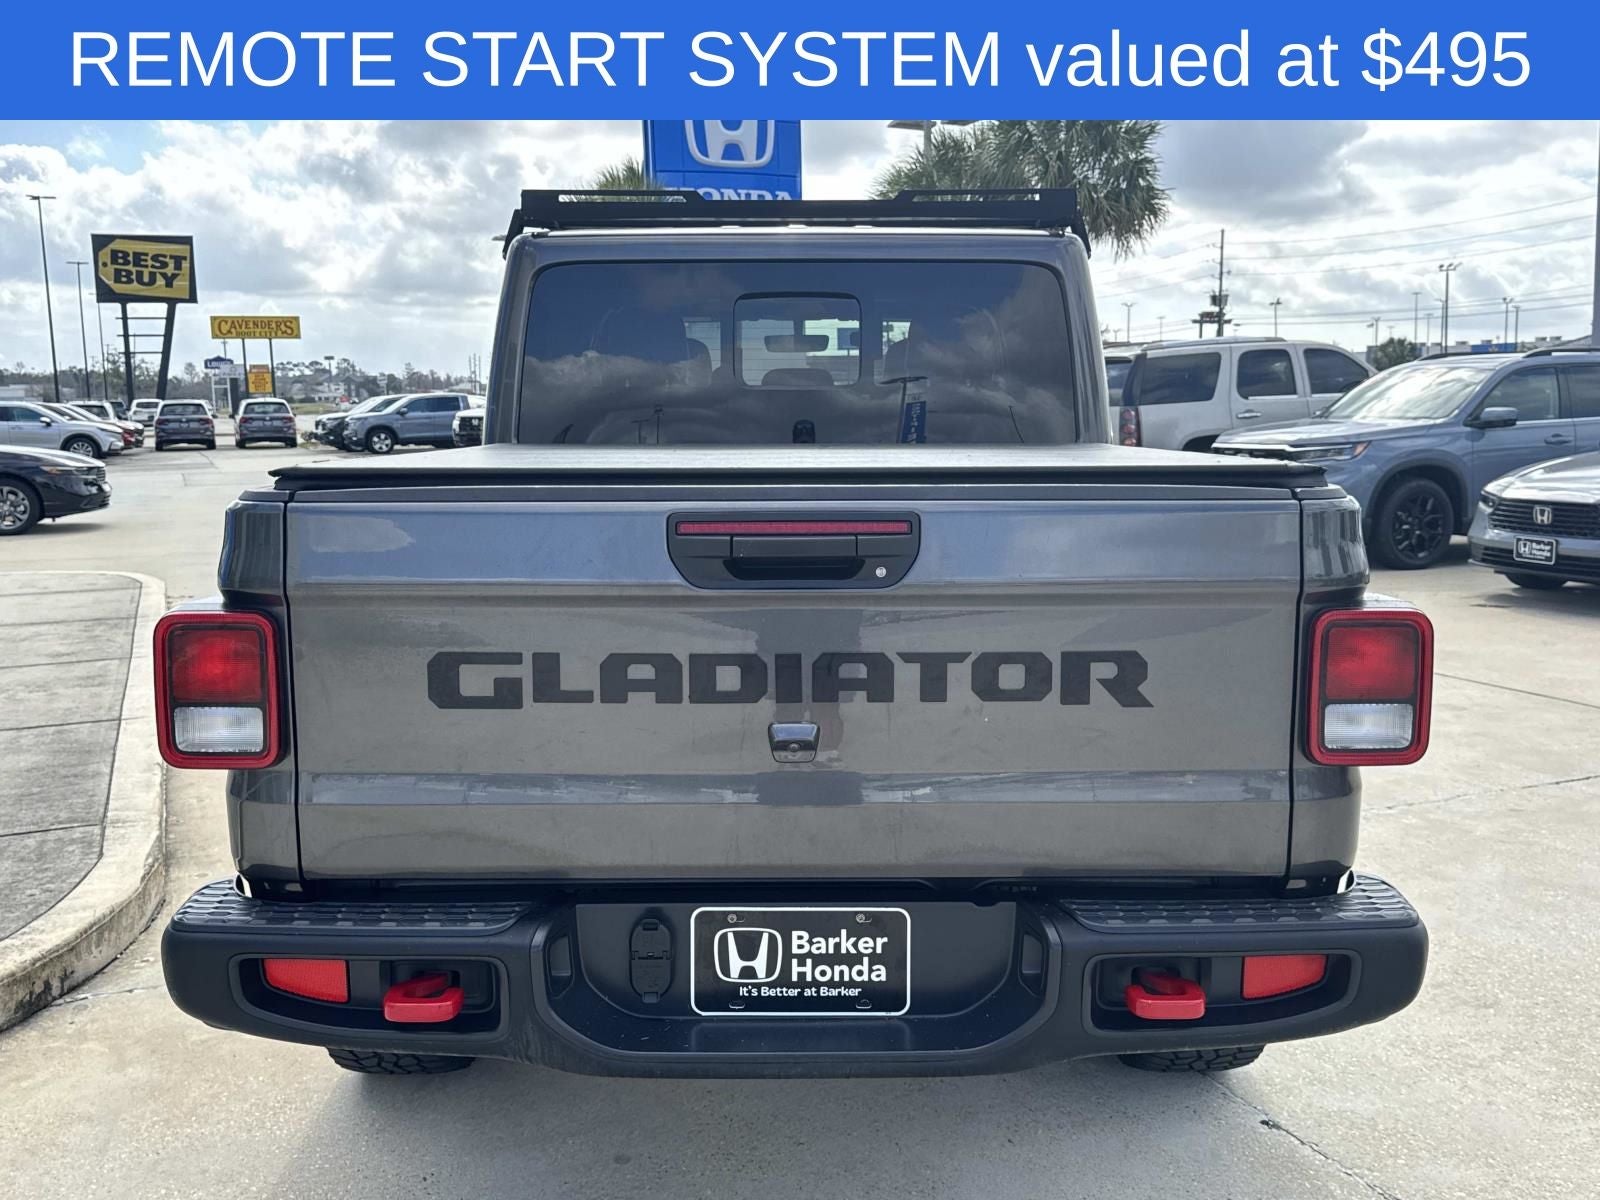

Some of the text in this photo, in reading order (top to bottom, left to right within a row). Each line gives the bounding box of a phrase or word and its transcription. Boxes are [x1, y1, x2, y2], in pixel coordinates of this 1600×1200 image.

[663, 187, 793, 200] ONDA
[110, 249, 187, 271] BEST
[113, 268, 180, 288] BUY
[217, 319, 294, 336] CAVENDER'S
[427, 651, 1154, 709] GLADIATOR
[791, 929, 888, 955] Barker
[791, 957, 887, 982] Honda
[739, 985, 861, 997] It's Better at Barker
